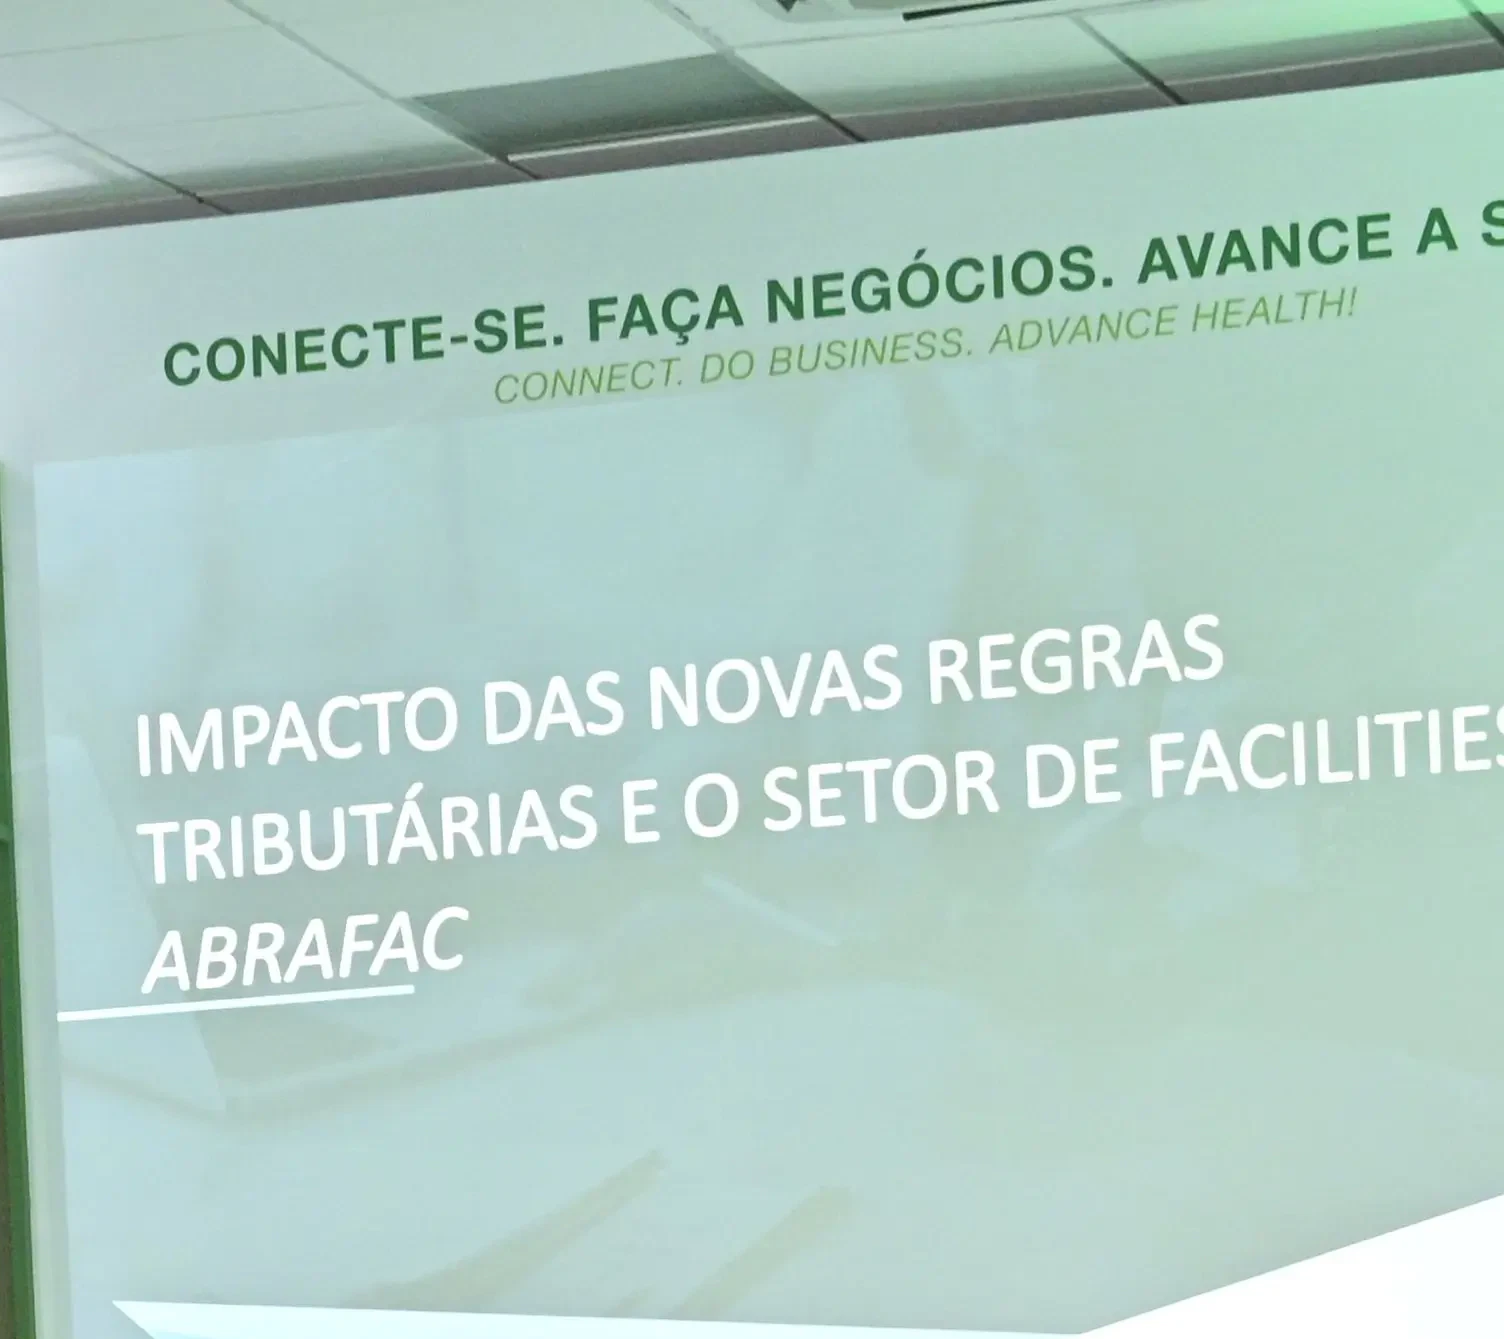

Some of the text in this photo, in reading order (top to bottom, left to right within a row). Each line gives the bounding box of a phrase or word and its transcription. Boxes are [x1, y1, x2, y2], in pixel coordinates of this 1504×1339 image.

[163, 304, 564, 388] CONECTE-SE.
[589, 282, 746, 347] FAÇA
[766, 244, 1114, 323] NEGÓCIOS.
[1136, 212, 1394, 285] AVANCE
[1416, 207, 1459, 255] A
[494, 286, 1359, 406] CONNECT. DO BUSINESS. ADVANCE HEALTH!
[134, 612, 1225, 777] IMPACTO DAS NOVAS REGRAS
[135, 781, 599, 885] TRIBUTÁRIAS
[623, 778, 661, 845] E
[683, 772, 740, 839] O
[761, 749, 1001, 833] SETOR
[1025, 737, 1123, 810] DE
[139, 905, 471, 994] ABRAFAC
